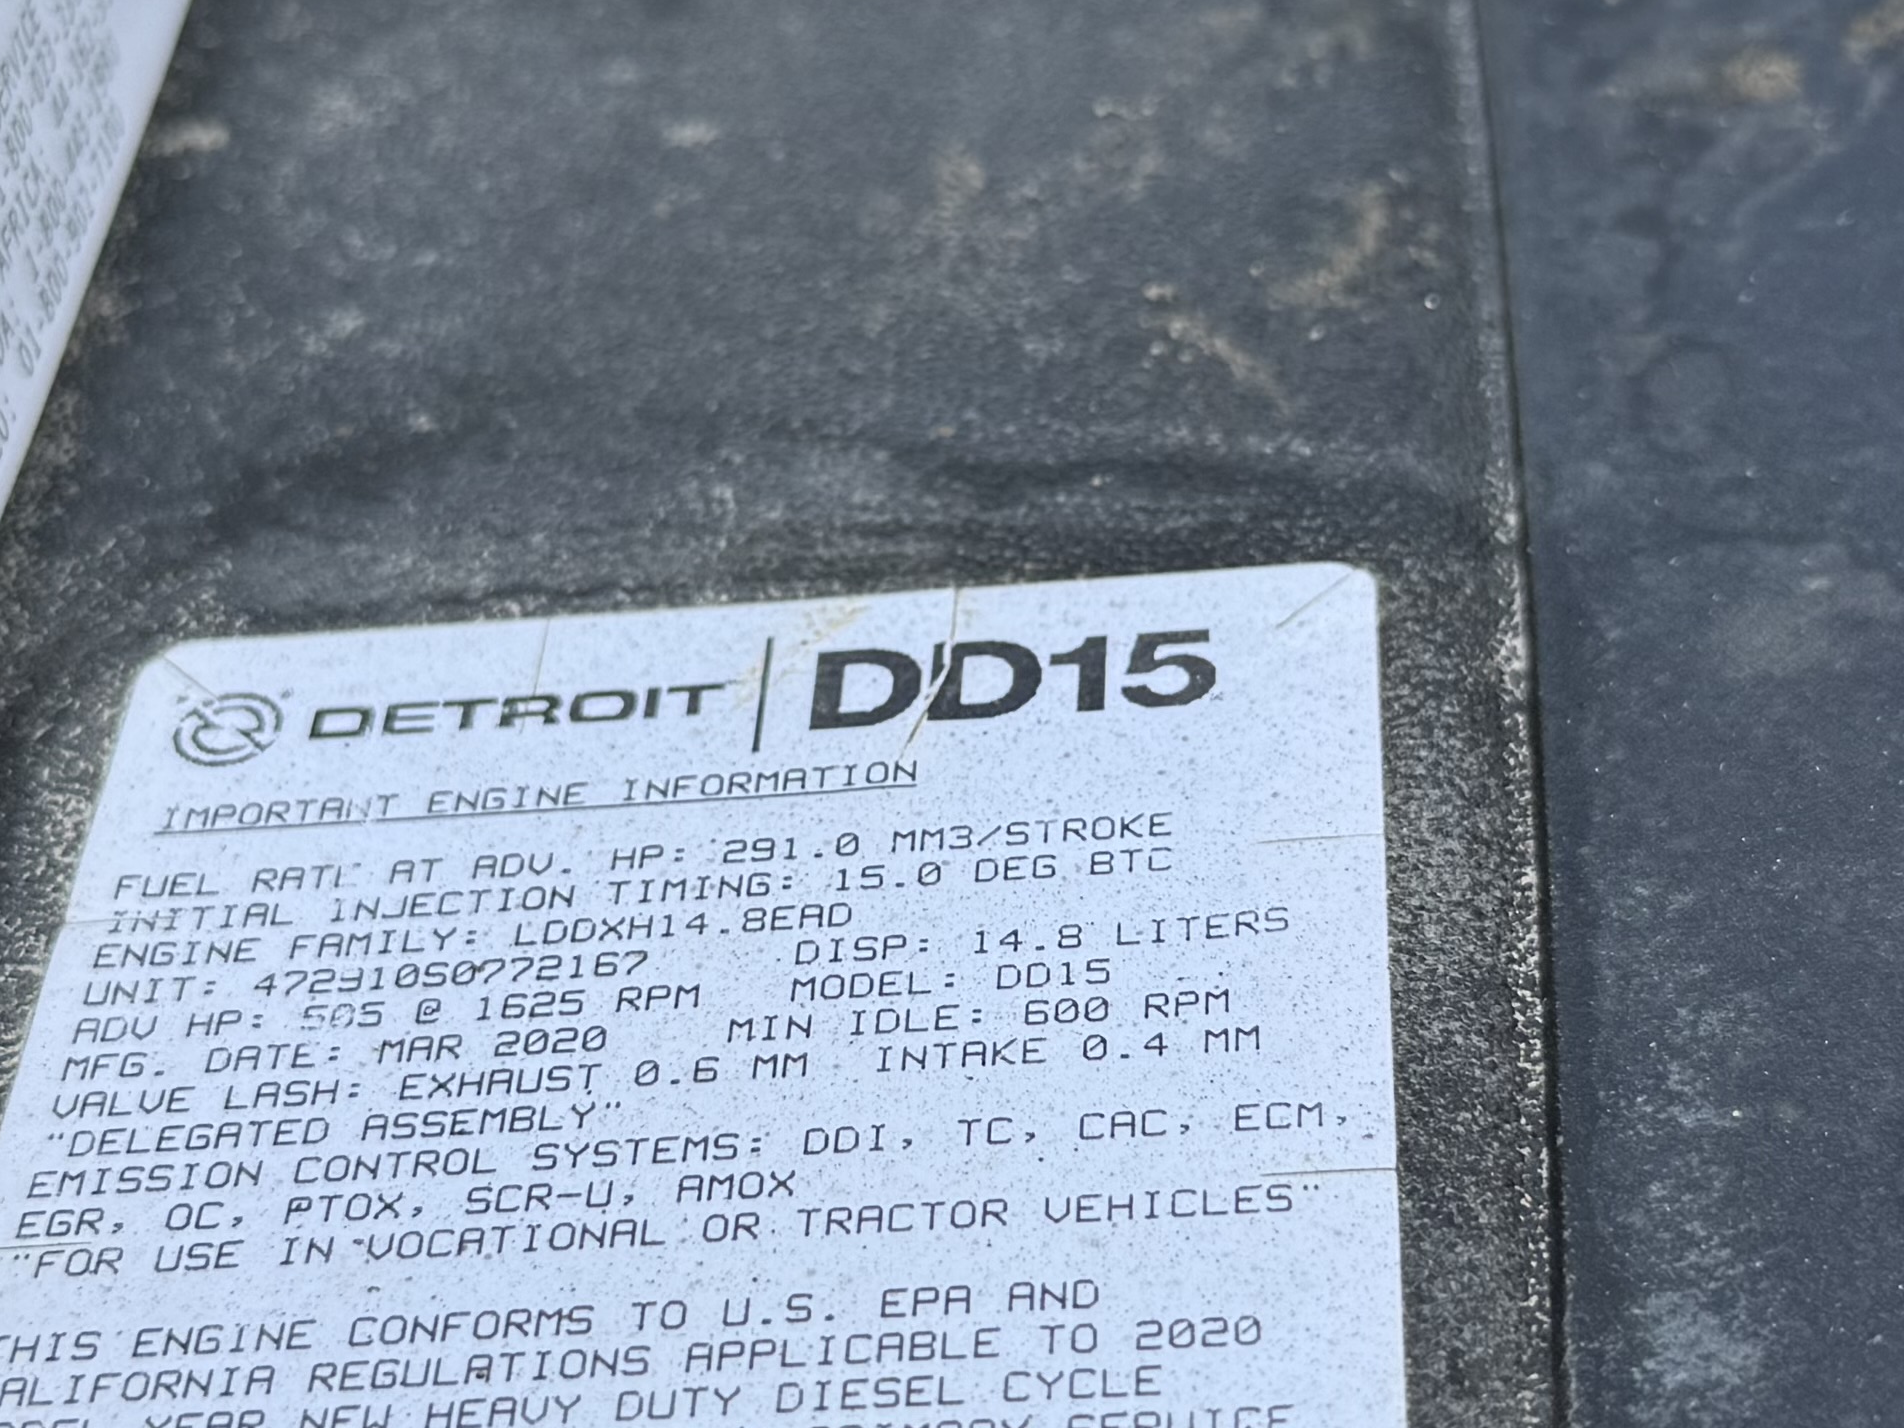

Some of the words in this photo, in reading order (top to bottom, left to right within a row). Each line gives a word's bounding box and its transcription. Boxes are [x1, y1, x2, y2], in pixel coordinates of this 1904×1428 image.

[308, 683, 726, 741] DETROIT
[808, 629, 1217, 730] DD15
[427, 781, 589, 815] ENGINE
[623, 760, 919, 804] INFORMATION
[107, 901, 294, 935] INITIAL
[329, 884, 577, 924] INJECTION
[607, 869, 797, 906] TIMING:
[834, 860, 943, 893] 15.0
[973, 853, 1058, 884] DEG
[1087, 845, 1174, 877] BTC
[112, 871, 220, 901] FUEL
[387, 857, 445, 886] AT
[470, 851, 572, 881] ADV.
[609, 843, 686, 872] HP:
[720, 831, 860, 866] 291.0
[888, 811, 1173, 855] MM3/STROKE
[81, 975, 218, 1008] UNIT:
[794, 933, 930, 967] DISP:
[973, 923, 1084, 955] 14.8
[1115, 905, 1290, 948] LITERS
[91, 936, 262, 970] ENGINE
[287, 926, 478, 961] FAMILY:
[508, 901, 854, 948] LDDXH14.8EAD
[59, 1051, 166, 1083] MFG.
[203, 1041, 342, 1075] DATE:
[371, 1033, 464, 1066] MAR
[492, 1024, 608, 1059] 2020
[725, 1013, 813, 1044] MIN
[849, 1003, 983, 1037] IDLE:
[1022, 995, 1113, 1027] 600
[1143, 987, 1230, 1020] RPM
[70, 1015, 159, 1046] ADV
[183, 1009, 264, 1039] HP:
[299, 1000, 386, 1032] 505
[474, 988, 587, 1022] 1625
[613, 982, 701, 1014] RPM
[789, 969, 956, 1003] MODEL:
[995, 957, 1111, 991] DD15
[50, 1085, 197, 1120] VALVE
[222, 1078, 361, 1114] LASH:
[397, 1062, 603, 1102] EXHAUST
[632, 1055, 721, 1088] 0.6
[750, 1051, 809, 1081] MM
[875, 1036, 1048, 1074] INTAKE
[1081, 1031, 1169, 1062] 0.4
[1203, 1024, 1261, 1055] MM
[25, 1159, 264, 1200] EMISSION
[292, 1146, 498, 1188] CONTROL
[530, 1131, 762, 1172] SYSTEMS:
[802, 1123, 914, 1157] DDI,
[957, 1116, 1037, 1147] TC,
[1078, 1108, 1191, 1142] CAC,
[1233, 1101, 1348, 1133] ECM,
[46, 1116, 331, 1159] "DELEGATED
[359, 1100, 622, 1143] ASSEMBLY"
[12, 1246, 125, 1280] "FOR
[152, 1238, 246, 1276] USE
[278, 1235, 335, 1268] IN
[365, 1217, 666, 1262] VOCATIONAL
[701, 1211, 761, 1244] OR
[796, 1197, 1009, 1238] TRACTOR
[1043, 1182, 1320, 1225] VEHICLES"
[13, 1207, 125, 1241] EGR,
[163, 1200, 244, 1233] OC,
[282, 1190, 424, 1226] PTOX,
[463, 1179, 635, 1216] SCR-U,
[675, 1169, 797, 1205] AMOX
[130, 1317, 318, 1360] ENGINE
[346, 1304, 596, 1349] CONFORMS
[630, 1299, 689, 1333] TO
[721, 1292, 836, 1331] U.S.
[878, 1284, 972, 1320] EPA
[1007, 1278, 1100, 1313] AND
[306, 1344, 652, 1395] REGULATIONS
[684, 1325, 1002, 1375] APPLICABLE
[1038, 1322, 1099, 1356] TO
[1135, 1314, 1263, 1352] 2020
[614, 1385, 742, 1423] DUTY
[774, 1374, 966, 1415] DIESEL
[1001, 1364, 1163, 1404] CYCLE
